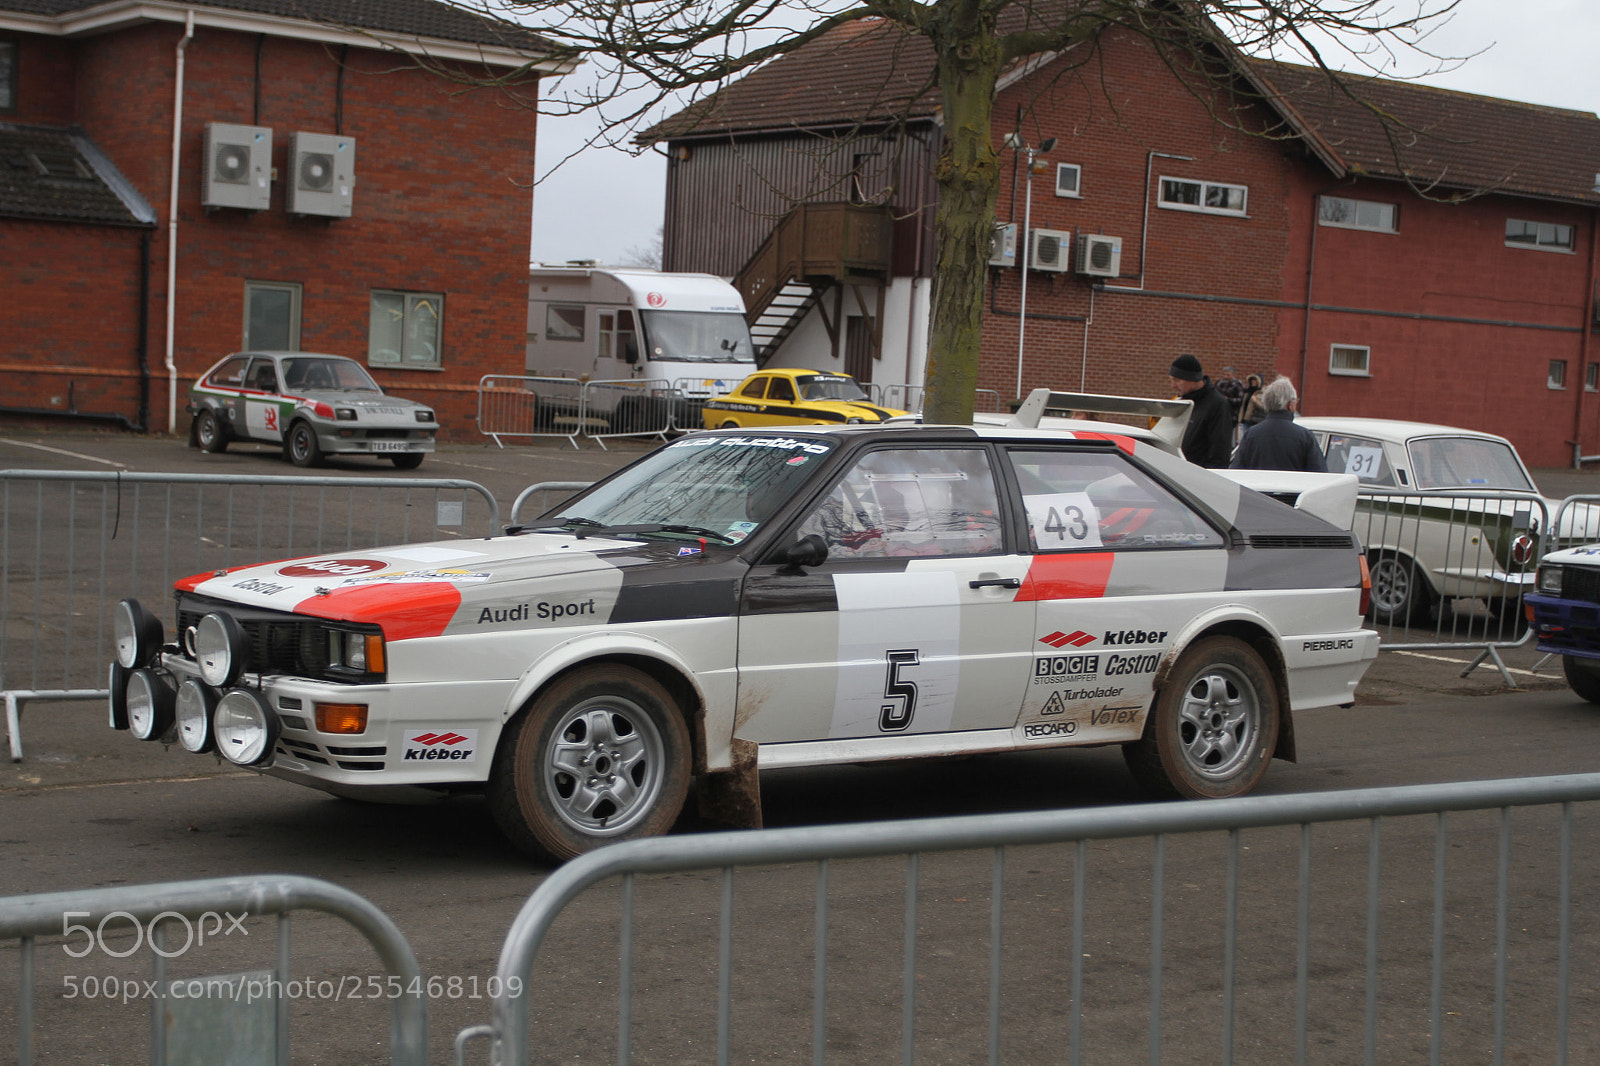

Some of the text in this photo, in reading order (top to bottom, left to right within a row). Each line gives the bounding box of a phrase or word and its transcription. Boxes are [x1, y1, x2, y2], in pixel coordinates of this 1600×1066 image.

[719, 437, 830, 455] quattro
[1351, 453, 1374, 474] 31
[1044, 505, 1089, 541] 43
[1143, 532, 1206, 543] quattro
[292, 560, 373, 575] Audi
[231, 578, 295, 596] Castrol
[477, 598, 596, 625] Audi Sport
[1102, 630, 1168, 646] kléber
[1302, 639, 1354, 651] PIERBURG
[1035, 655, 1100, 677] BOGE
[1104, 652, 1162, 676] Castrol
[878, 648, 920, 733] 5
[1063, 687, 1124, 701] Turbolader
[1024, 721, 1077, 738] RECARO
[403, 748, 473, 760] kléber
